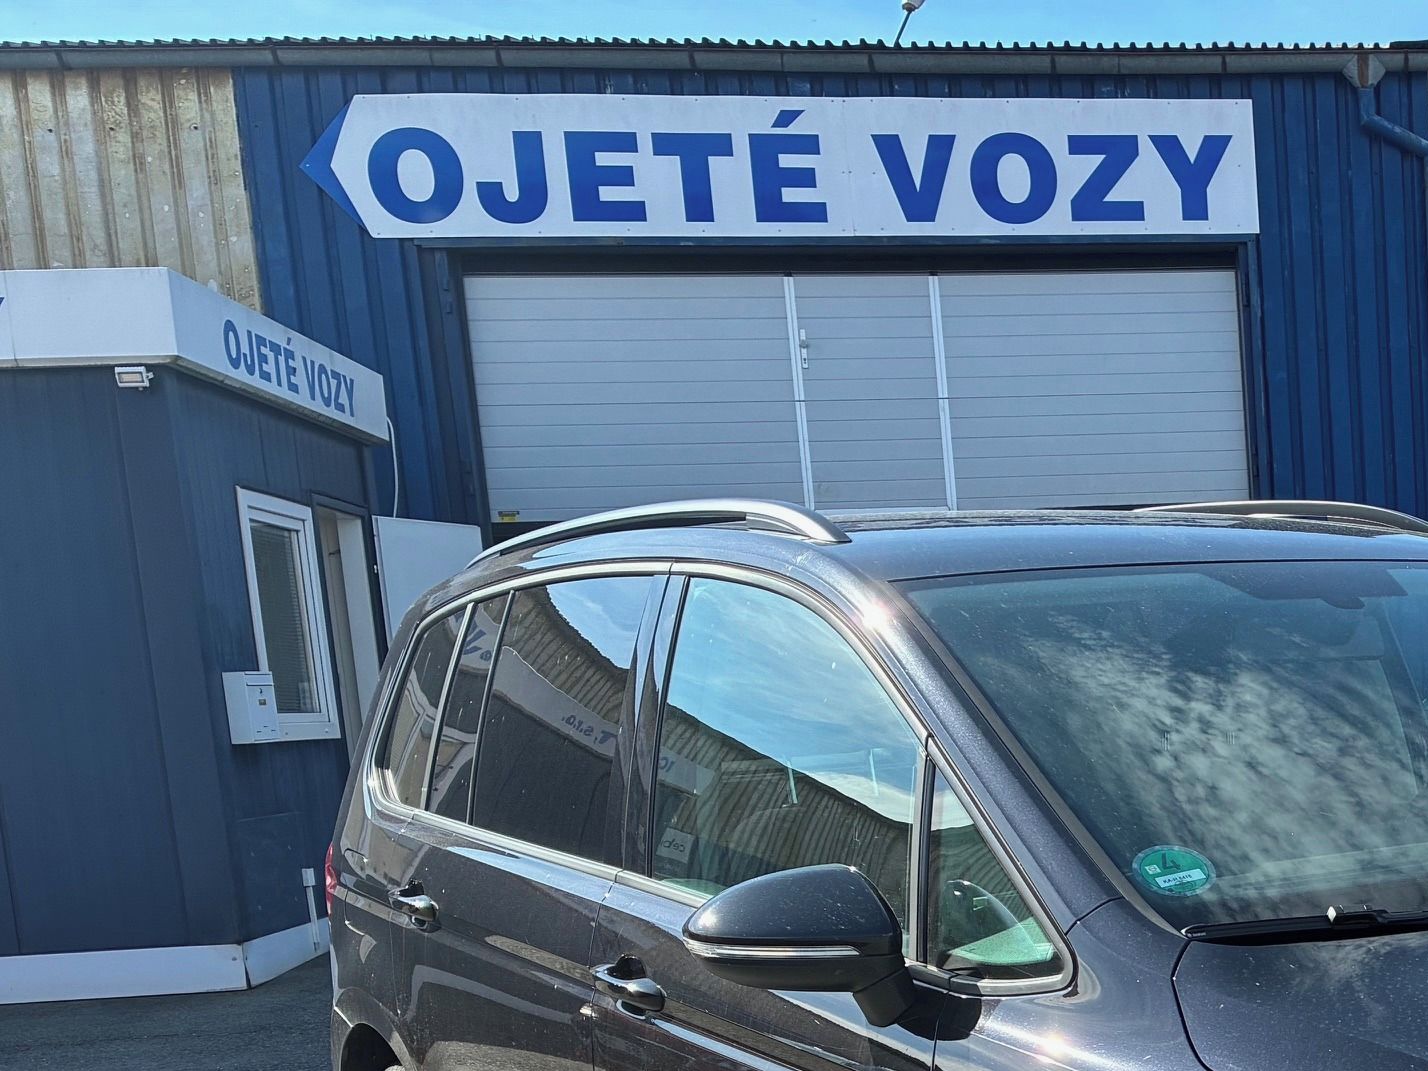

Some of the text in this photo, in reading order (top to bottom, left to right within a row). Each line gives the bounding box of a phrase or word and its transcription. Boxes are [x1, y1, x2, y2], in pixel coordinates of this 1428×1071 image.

[367, 109, 1233, 225] OJETÉ VOZY
[223, 319, 355, 418] OJETÉ VOZY
[1161, 851, 1182, 870] 4
